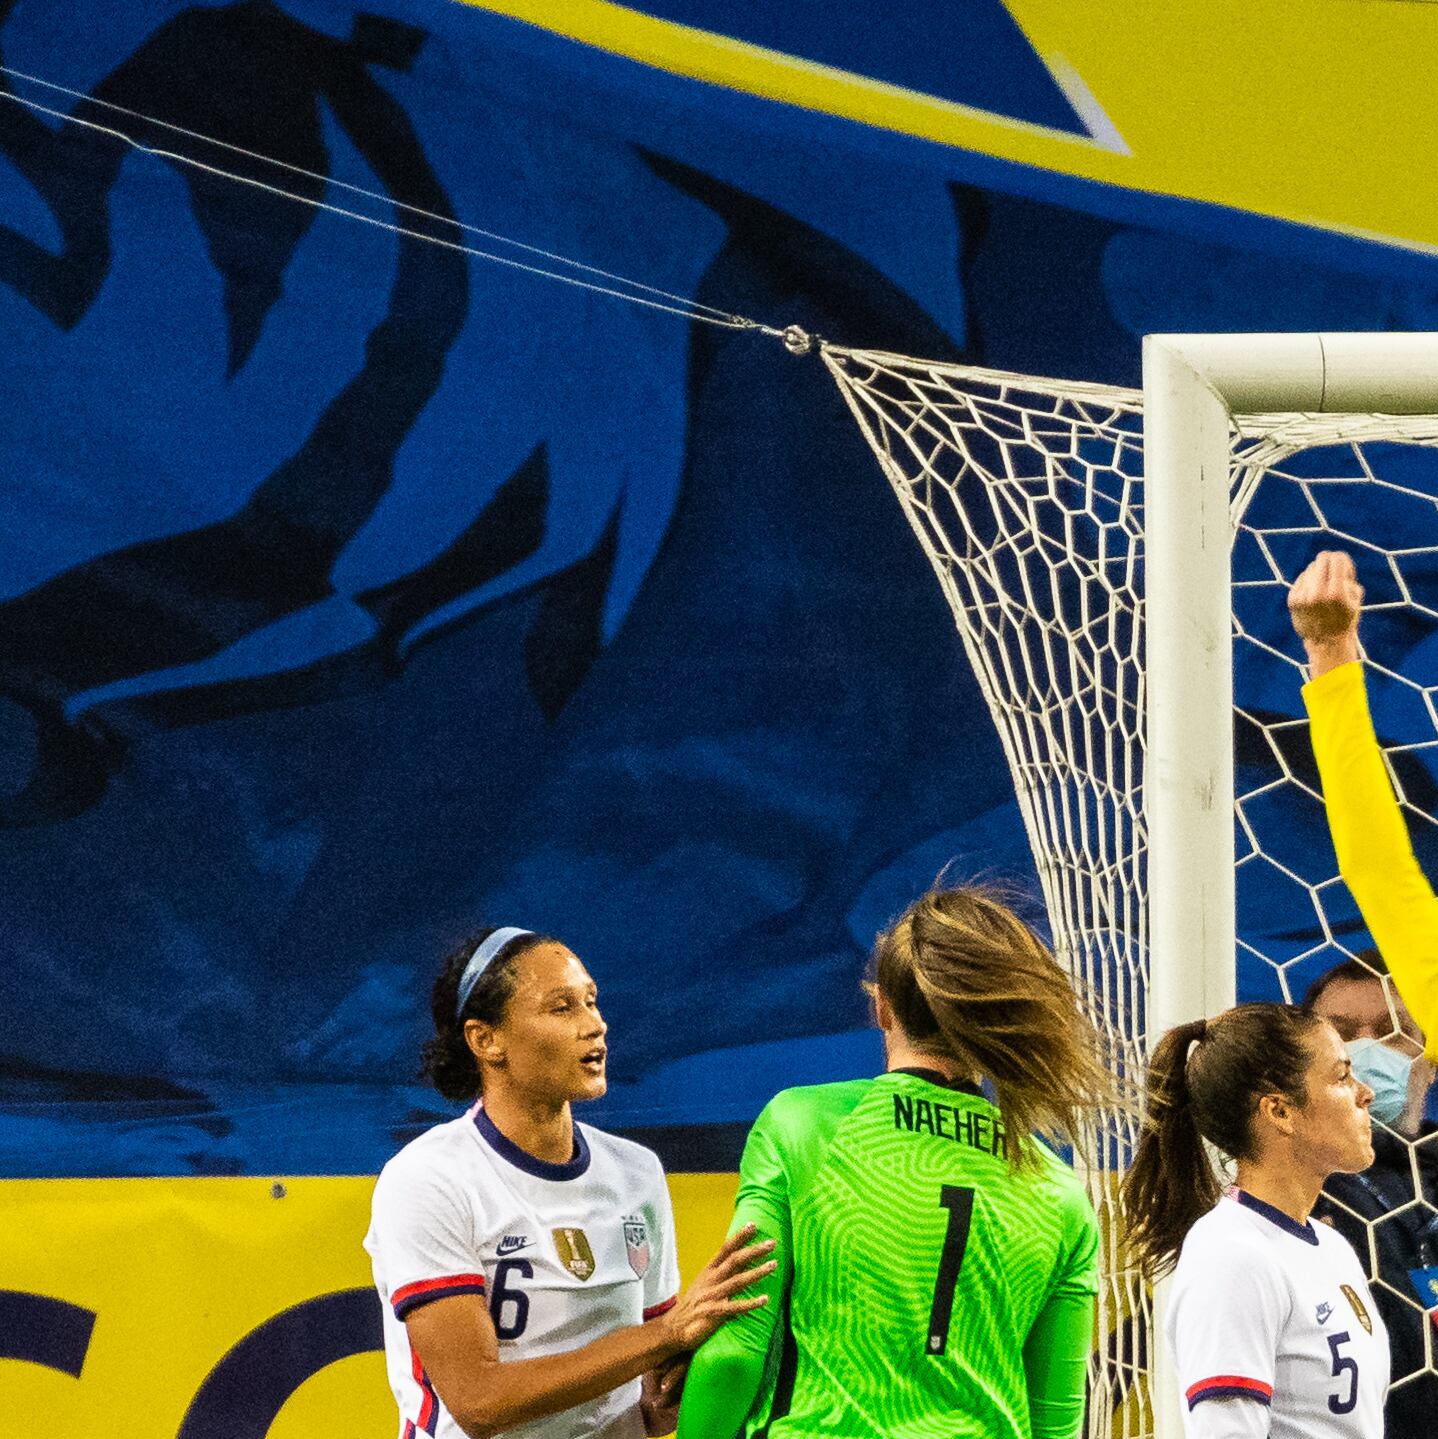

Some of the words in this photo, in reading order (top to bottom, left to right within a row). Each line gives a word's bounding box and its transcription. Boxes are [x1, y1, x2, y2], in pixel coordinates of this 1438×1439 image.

[501, 1235, 527, 1248] NIKE
[924, 1183, 976, 1356] 1
[490, 1257, 534, 1340] 6
[1327, 1331, 1359, 1415] 5
